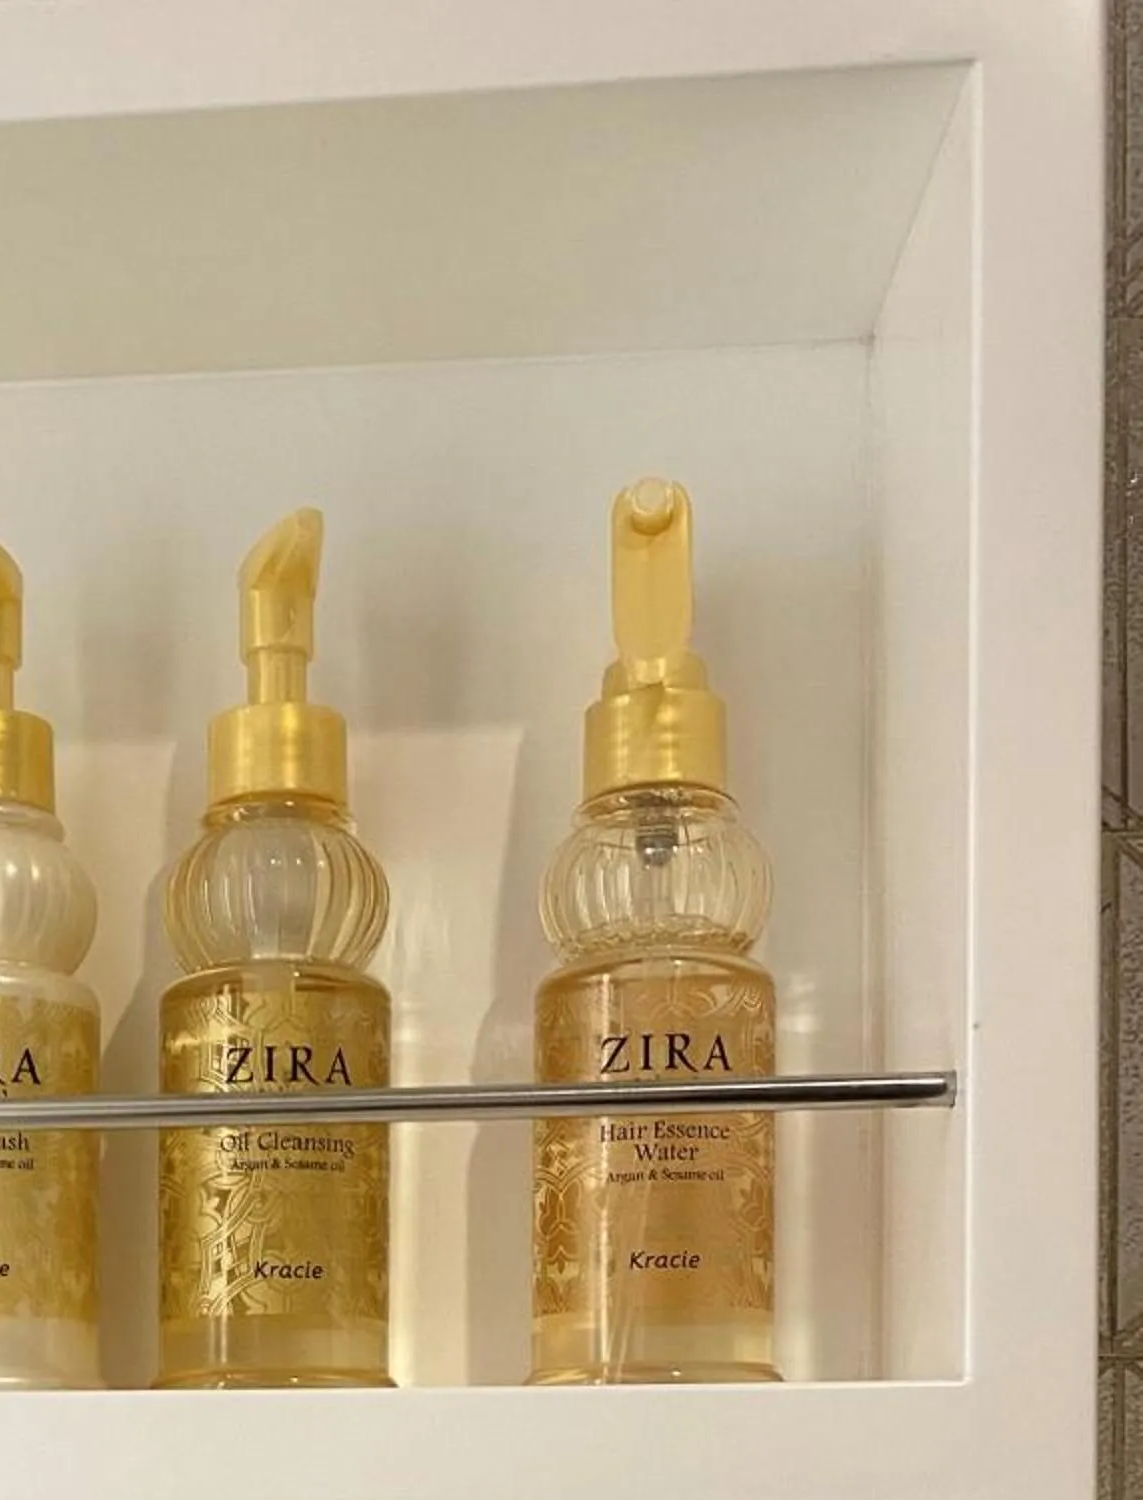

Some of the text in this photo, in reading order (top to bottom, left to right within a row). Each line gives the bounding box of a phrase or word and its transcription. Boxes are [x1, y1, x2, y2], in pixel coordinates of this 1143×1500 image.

[600, 1033, 732, 1074] ZIRA
[226, 1046, 352, 1085] ZIRA
[600, 1120, 730, 1143] Hair Essence
[220, 1131, 355, 1159] Oil Cleansing
[635, 1144, 699, 1162] Water
[18, 1158, 34, 1171] oil
[662, 1169, 707, 1182] Sesame
[708, 1170, 724, 1182] oil
[629, 1250, 700, 1269] Kracie
[253, 1260, 324, 1279] Kracie
